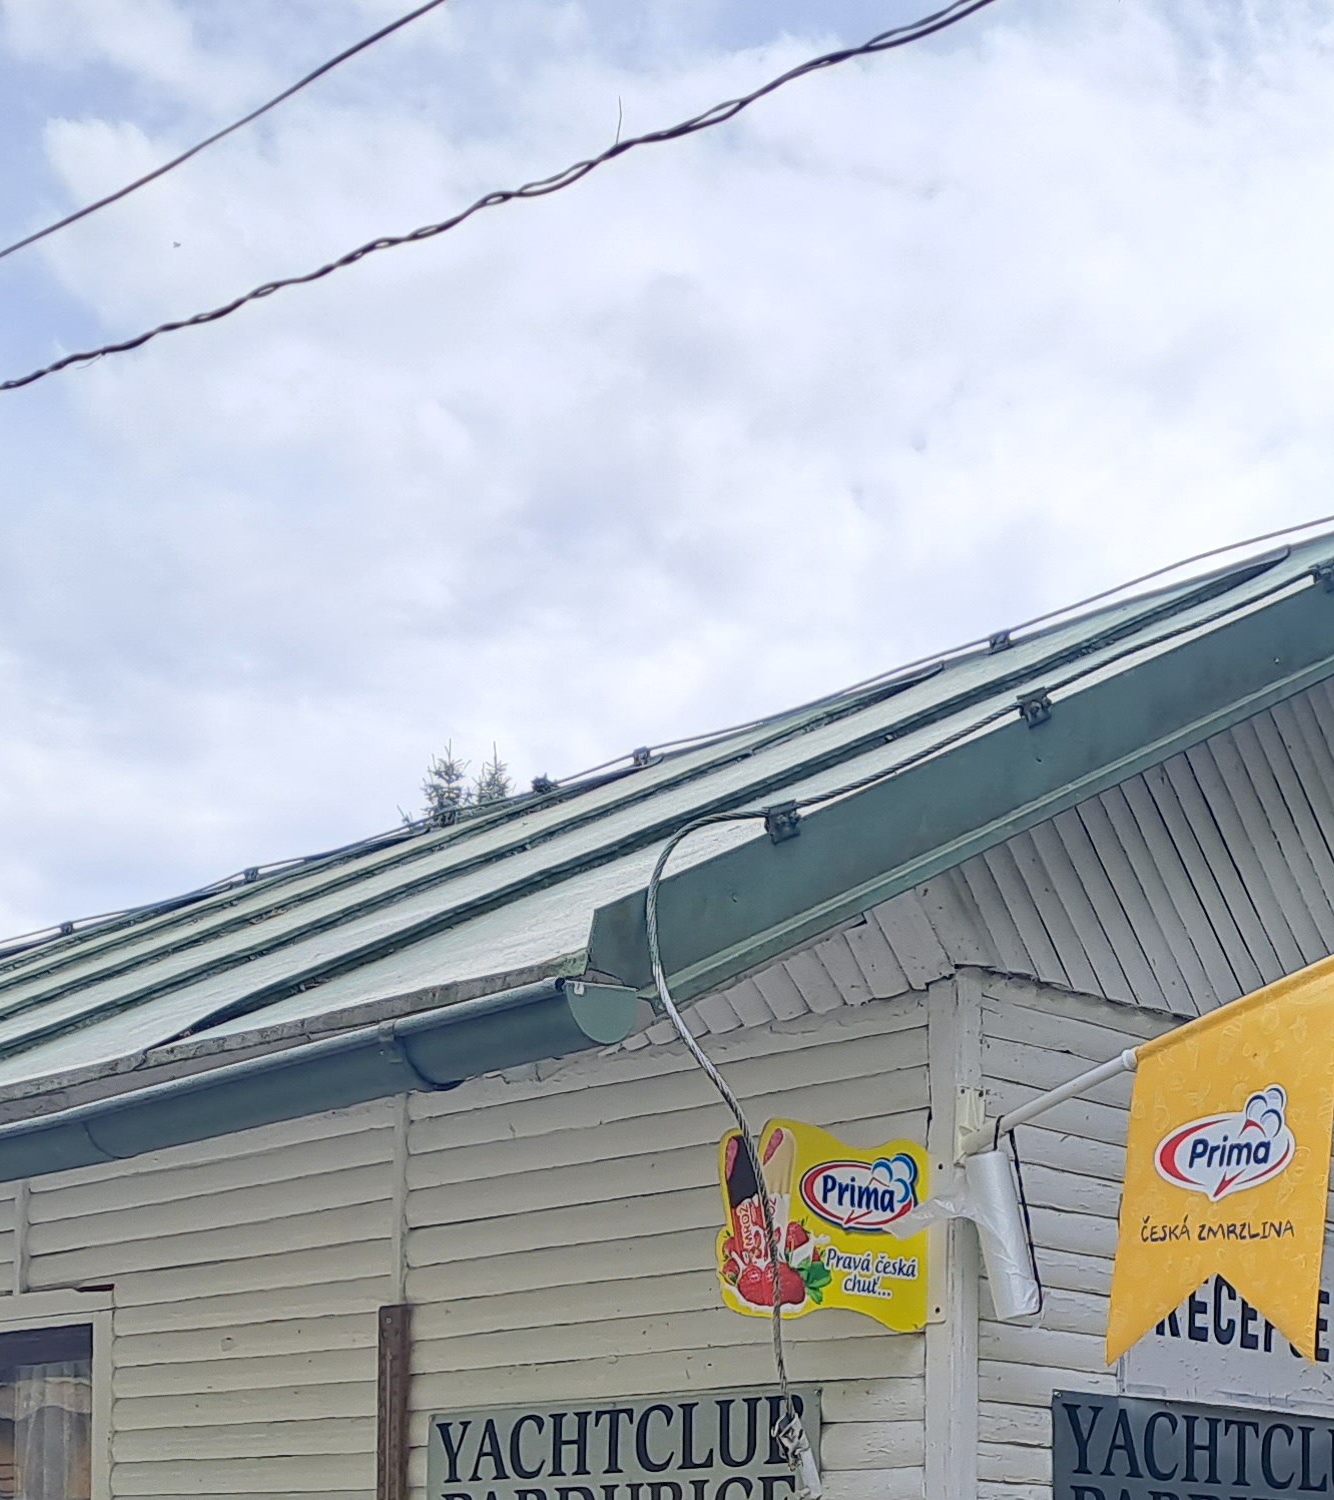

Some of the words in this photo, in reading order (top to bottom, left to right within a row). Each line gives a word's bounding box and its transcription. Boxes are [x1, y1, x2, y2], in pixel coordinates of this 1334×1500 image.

[1189, 1135, 1271, 1169] Prima
[822, 1174, 895, 1213] Prima
[1141, 1214, 1191, 1243] ČESKÁ
[1197, 1219, 1295, 1241] ZMRZLINA
[826, 1248, 871, 1273] Pravá
[875, 1250, 918, 1278] česká
[1156, 1273, 1330, 1363] ECEE
